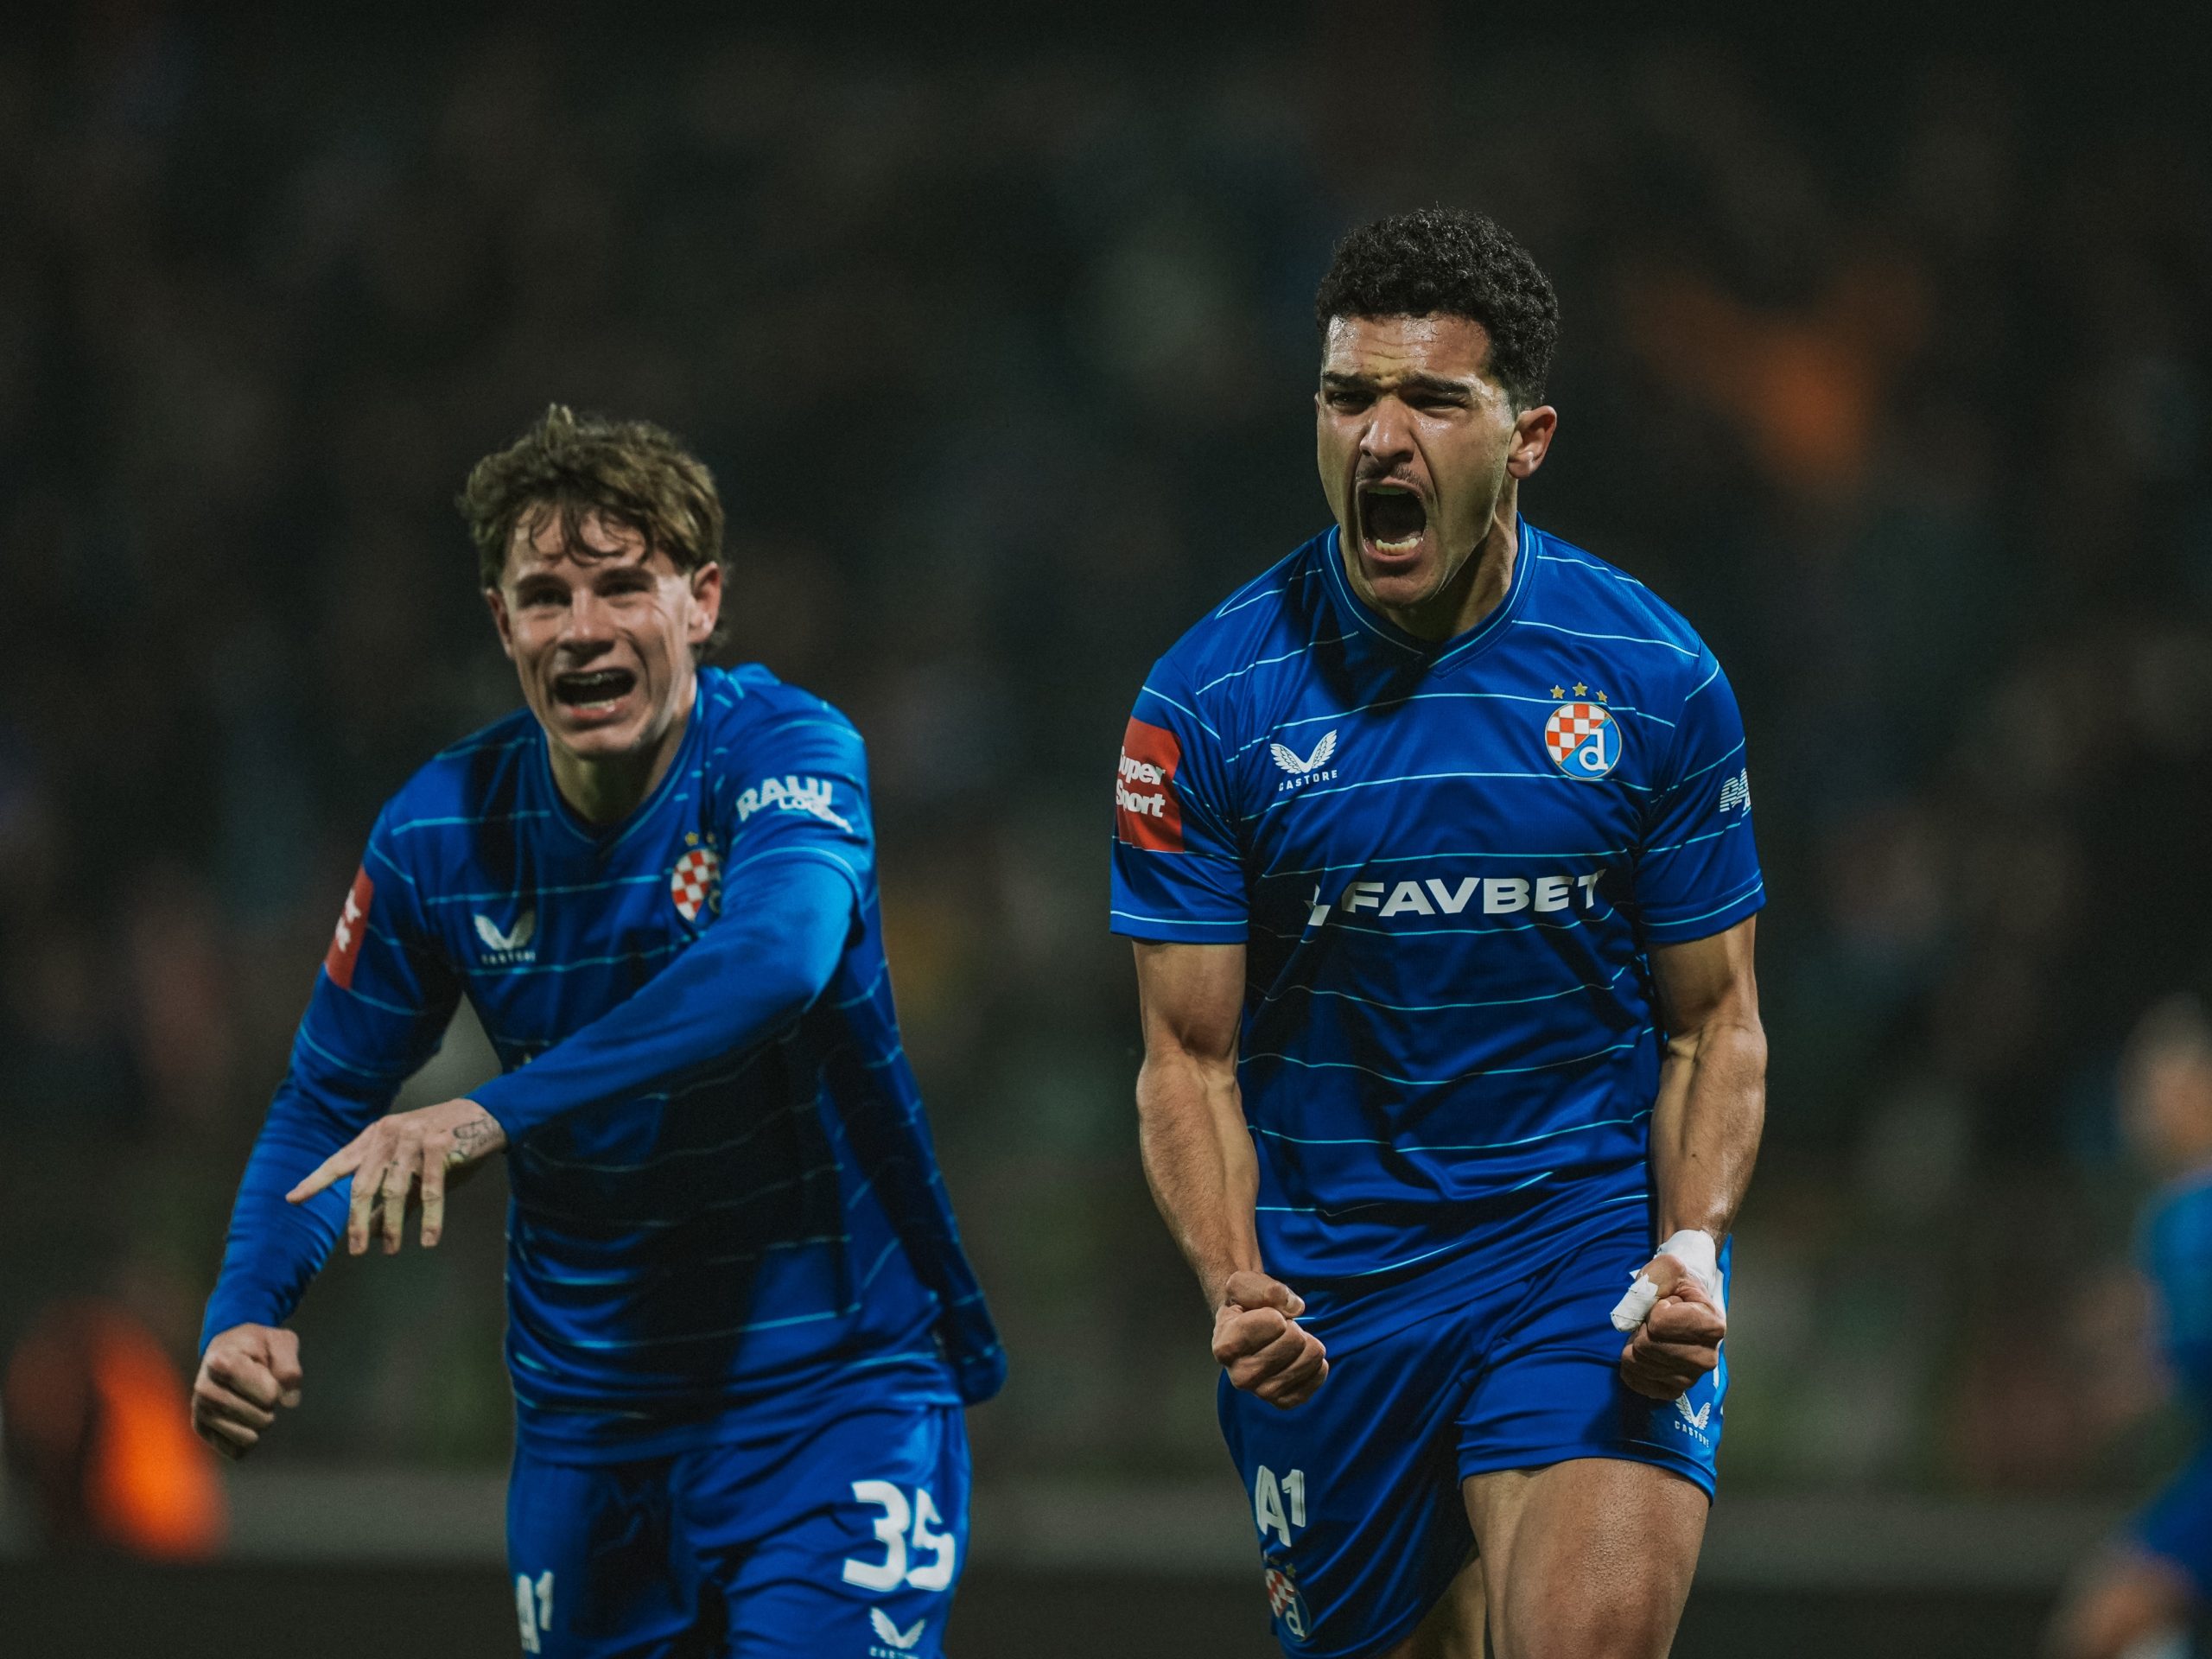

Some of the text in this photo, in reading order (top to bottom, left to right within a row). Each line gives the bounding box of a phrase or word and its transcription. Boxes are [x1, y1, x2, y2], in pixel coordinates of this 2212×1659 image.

[1118, 746, 1166, 785] uper
[1278, 769, 1338, 791] CASTORE
[1341, 868, 1606, 918] FAVBET
[1675, 1421, 1710, 1448] CASTORE
[1255, 1465, 1306, 1548] A1
[842, 1479, 956, 1592] 35
